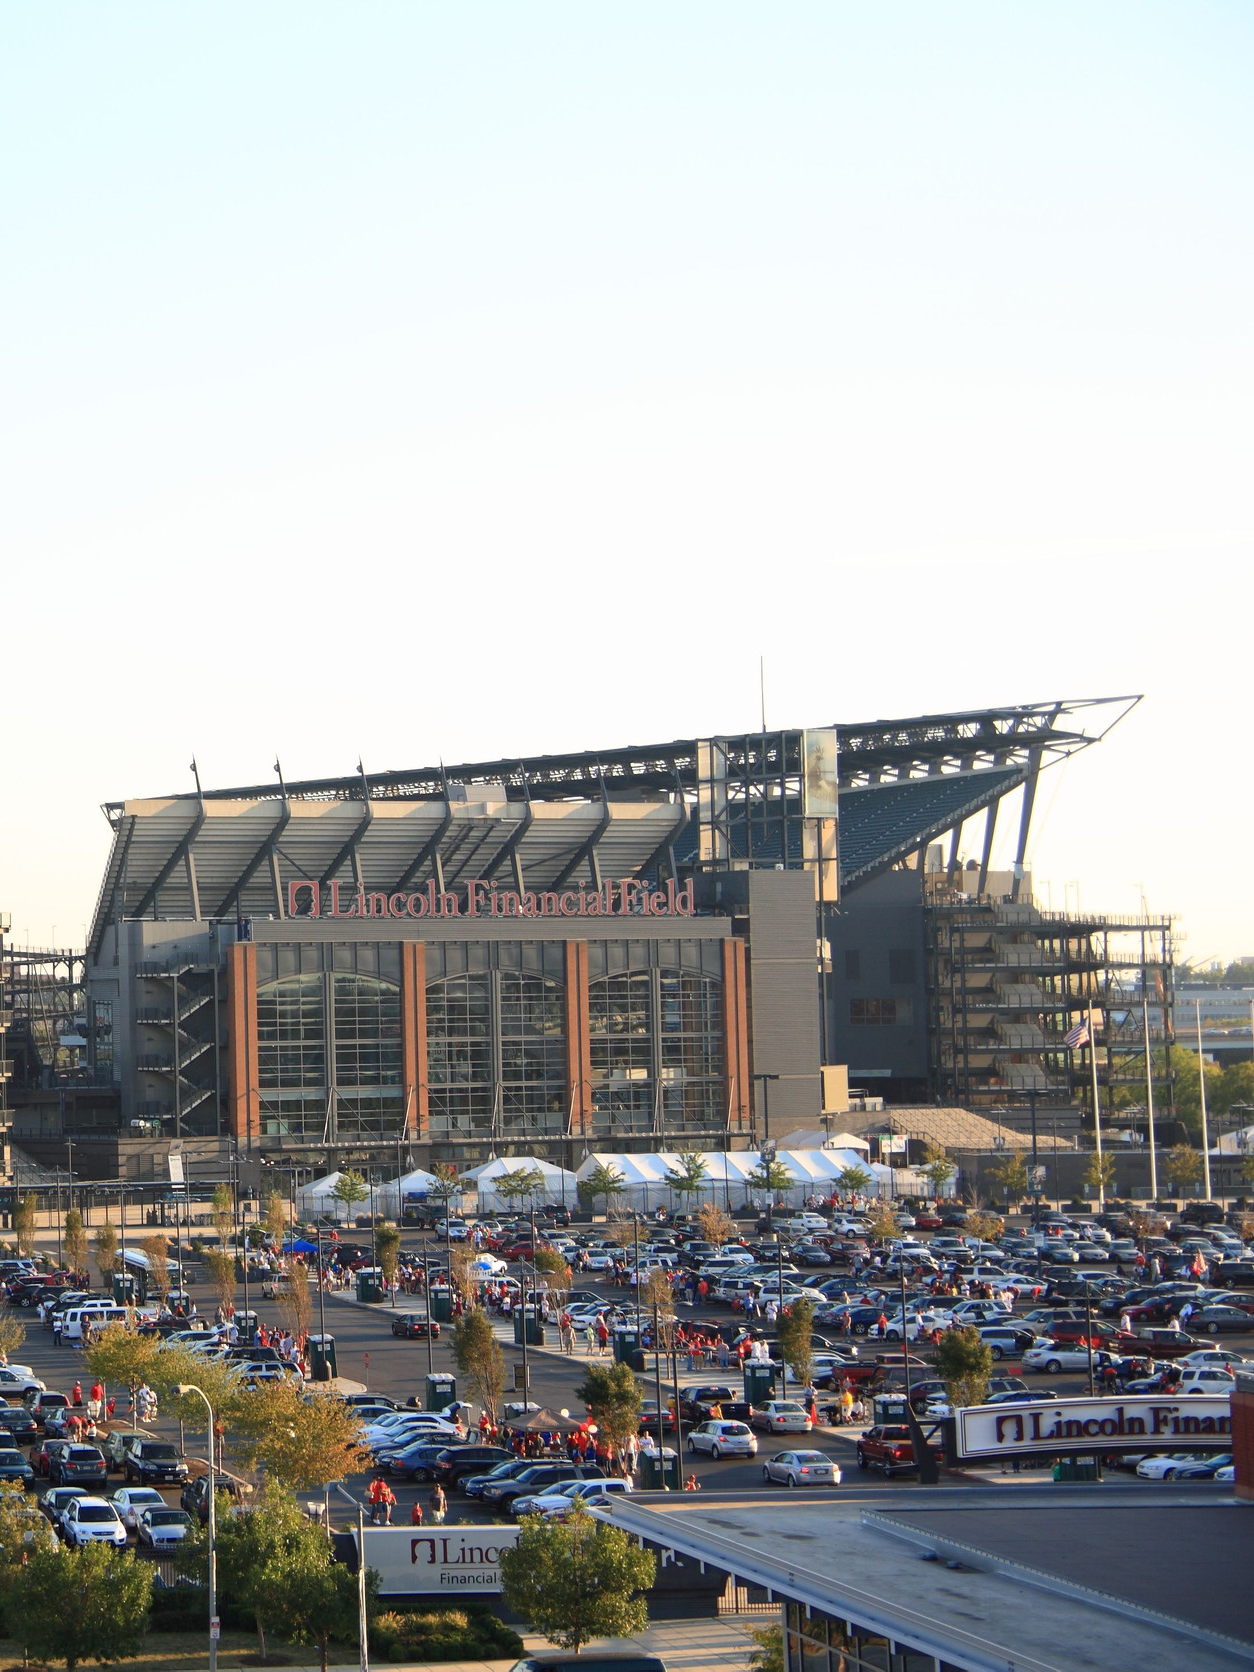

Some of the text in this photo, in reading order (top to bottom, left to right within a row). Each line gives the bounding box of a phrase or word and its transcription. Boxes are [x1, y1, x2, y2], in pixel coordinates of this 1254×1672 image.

[326, 877, 696, 917] Lincoln Financial Field
[1030, 1406, 1231, 1440] Lincoln Finan
[440, 1572, 497, 1585] Financial
